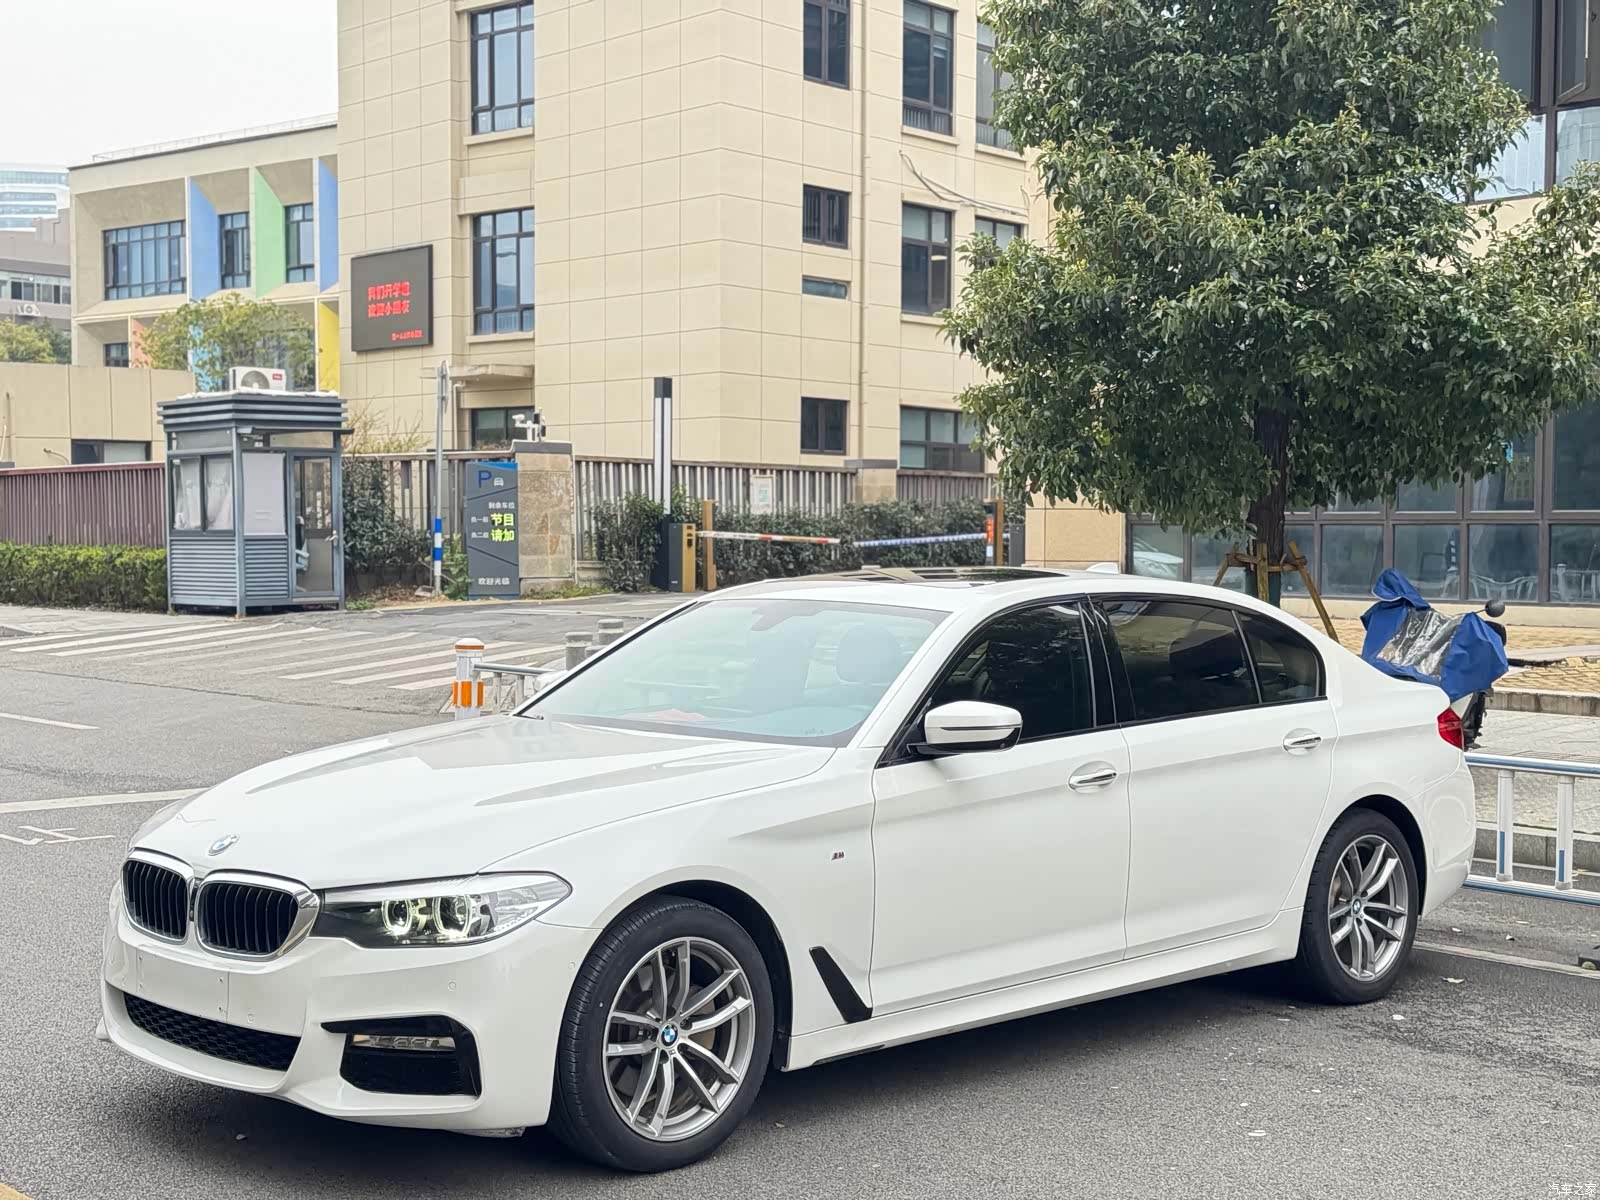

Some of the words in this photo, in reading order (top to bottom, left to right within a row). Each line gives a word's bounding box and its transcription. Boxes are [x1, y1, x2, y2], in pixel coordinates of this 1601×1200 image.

[490, 513, 514, 526] 节目
[491, 528, 515, 542] 请加
[478, 577, 510, 585] 欢迎光临
